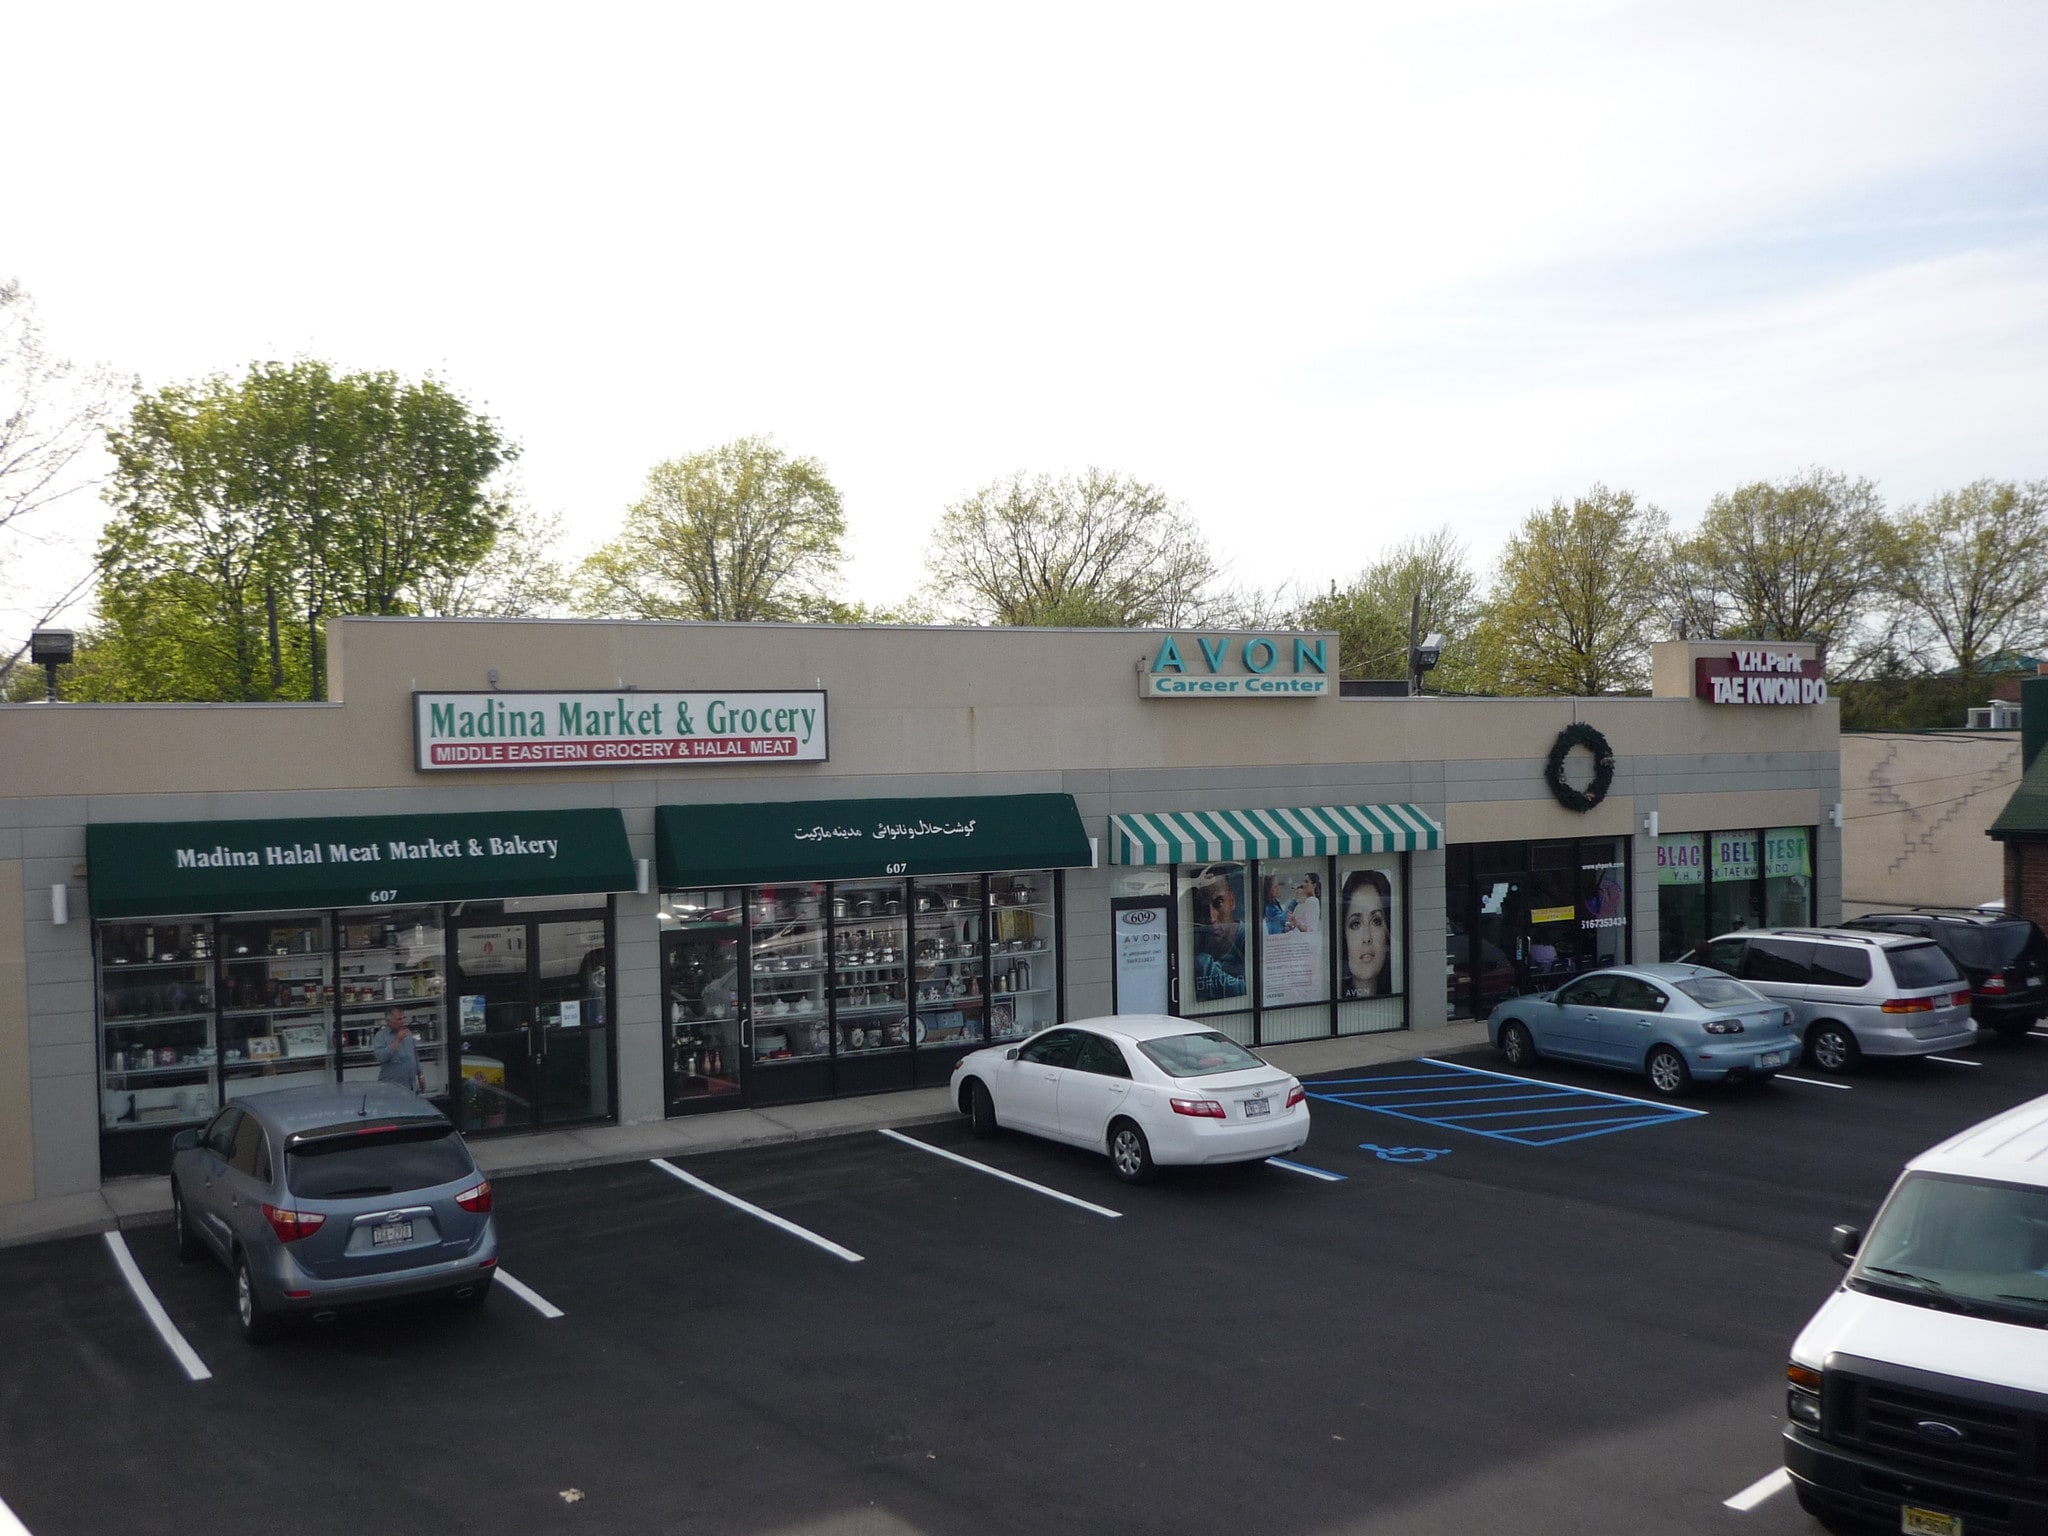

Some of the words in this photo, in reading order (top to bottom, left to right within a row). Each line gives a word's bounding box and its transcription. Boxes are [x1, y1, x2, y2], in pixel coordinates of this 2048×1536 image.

[1151, 635, 1327, 674] AVON
[1155, 678, 1239, 692] Career
[1245, 677, 1324, 692] Center
[430, 698, 545, 738] Madina
[558, 698, 663, 736] Market
[676, 700, 694, 735] &
[707, 699, 817, 744] Grocery
[436, 745, 503, 762] MIDDLE
[508, 744, 588, 760] EASTERN
[593, 742, 674, 758] GROCERY
[678, 741, 690, 756] &
[693, 740, 747, 756] HALAL
[750, 740, 793, 755] MEAT
[176, 845, 260, 869] Madina
[267, 842, 323, 867] Halal
[330, 843, 382, 864] Meat
[389, 839, 462, 861] Market
[468, 839, 485, 857] &
[490, 835, 559, 859] Bakery
[1767, 838, 1805, 859] TEST
[886, 863, 907, 874] 607
[370, 889, 398, 903] 607
[1131, 912, 1151, 923] 609
[1124, 933, 1161, 943] AVON
[1345, 988, 1370, 997] AVON
